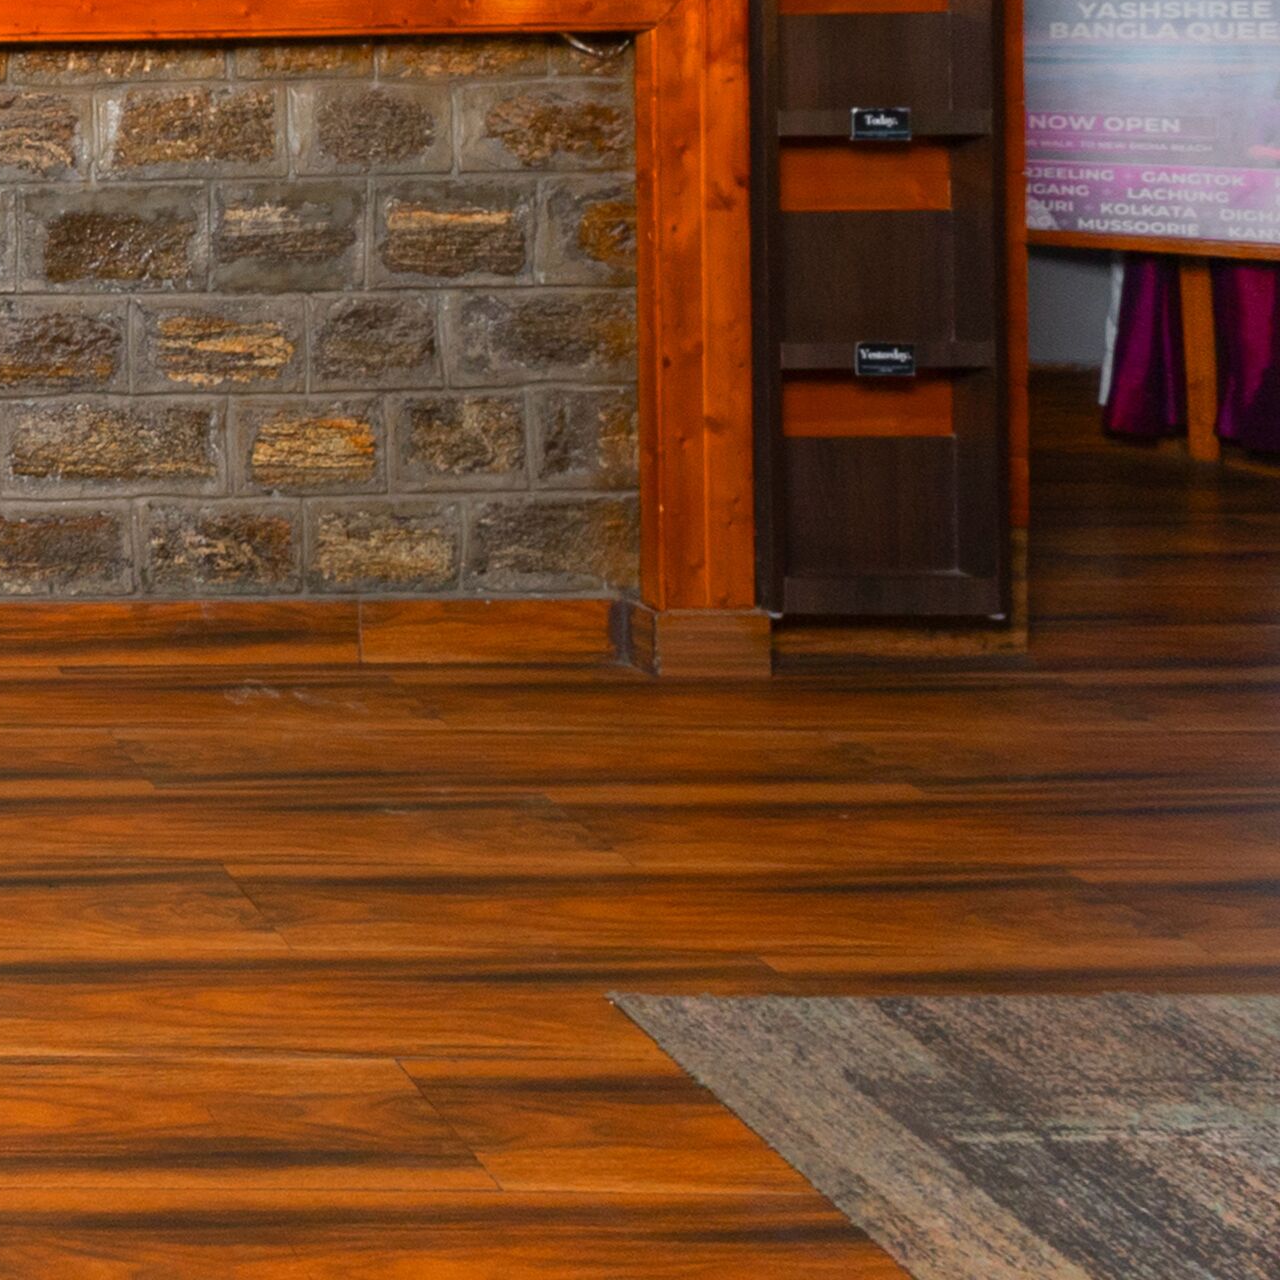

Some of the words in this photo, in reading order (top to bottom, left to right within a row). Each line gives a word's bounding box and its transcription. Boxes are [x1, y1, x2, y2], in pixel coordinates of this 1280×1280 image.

[1078, 1, 1272, 19] YASHSHREE
[1049, 22, 1178, 39] BANGLA
[1185, 22, 1280, 41] QUEE
[1029, 115, 1095, 130] NOW
[1103, 116, 1181, 133] OPEN
[1142, 171, 1245, 186] GANGTOK
[1127, 187, 1230, 203] LACHUNG
[1100, 202, 1198, 218] KOLKATA
[1078, 218, 1201, 236] MUSSOORIE
